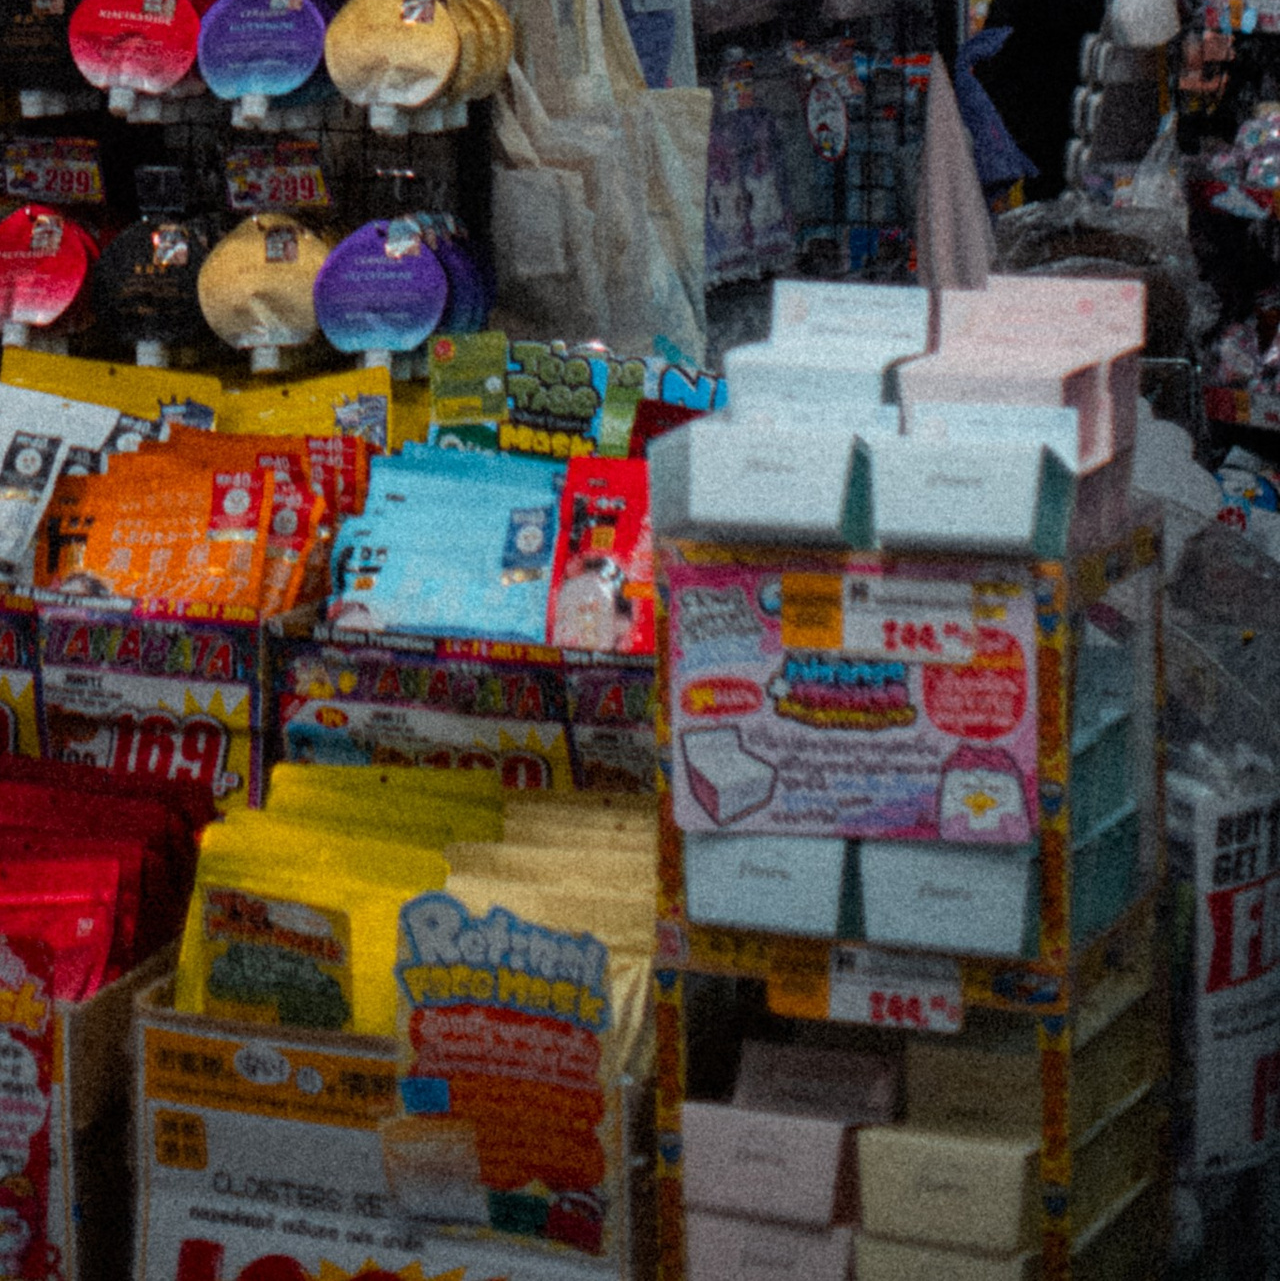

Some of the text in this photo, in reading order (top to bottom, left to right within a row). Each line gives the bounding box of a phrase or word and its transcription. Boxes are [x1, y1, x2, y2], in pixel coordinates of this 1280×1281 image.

[45, 168, 91, 195] 299
[268, 177, 316, 202] 299
[113, 713, 221, 780] 169
[401, 963, 607, 1020] Face Mask
